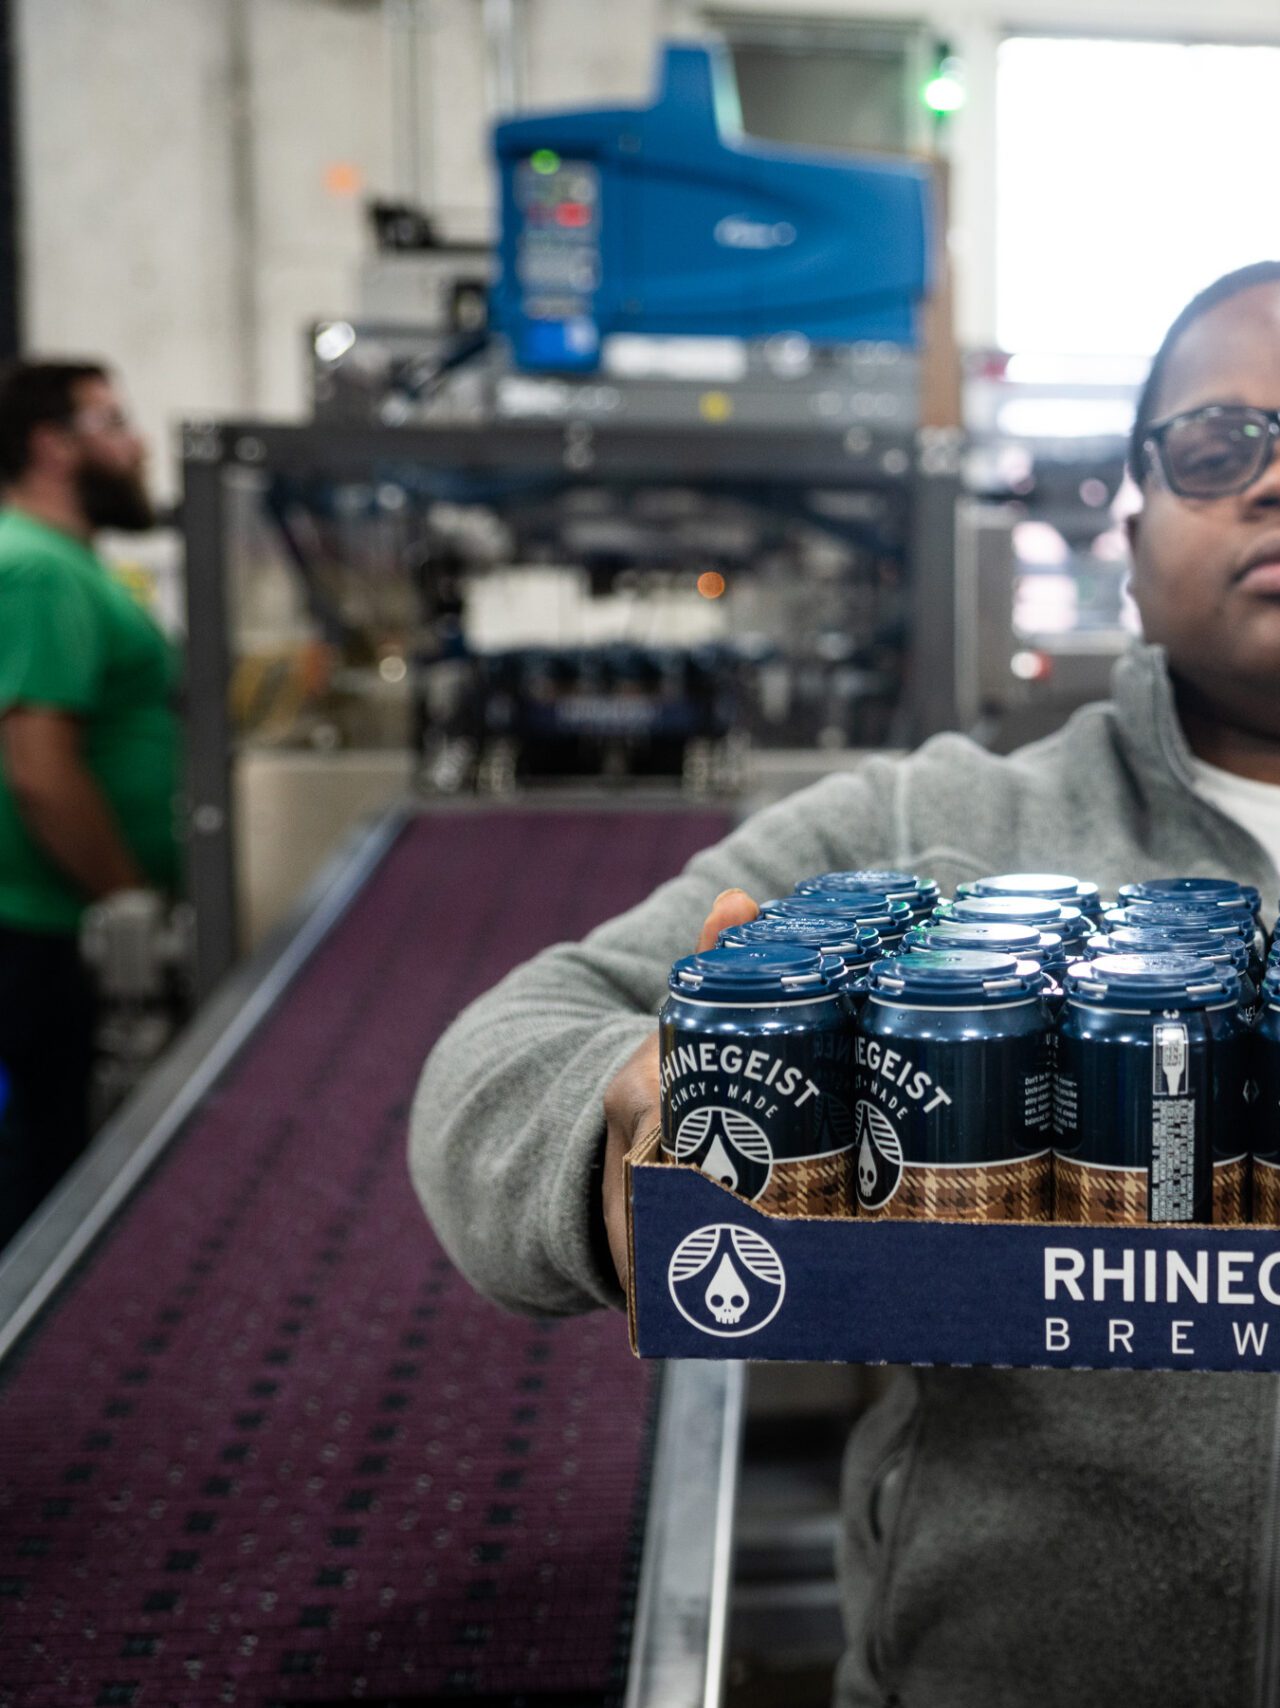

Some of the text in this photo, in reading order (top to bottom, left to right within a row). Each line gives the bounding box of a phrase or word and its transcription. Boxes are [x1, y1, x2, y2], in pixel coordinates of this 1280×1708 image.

[660, 1042, 820, 1108] RHINEGEIST
[670, 1081, 779, 1119] CINCY MADE
[855, 1036, 952, 1114] EGEIST
[870, 1080, 908, 1120] MADE
